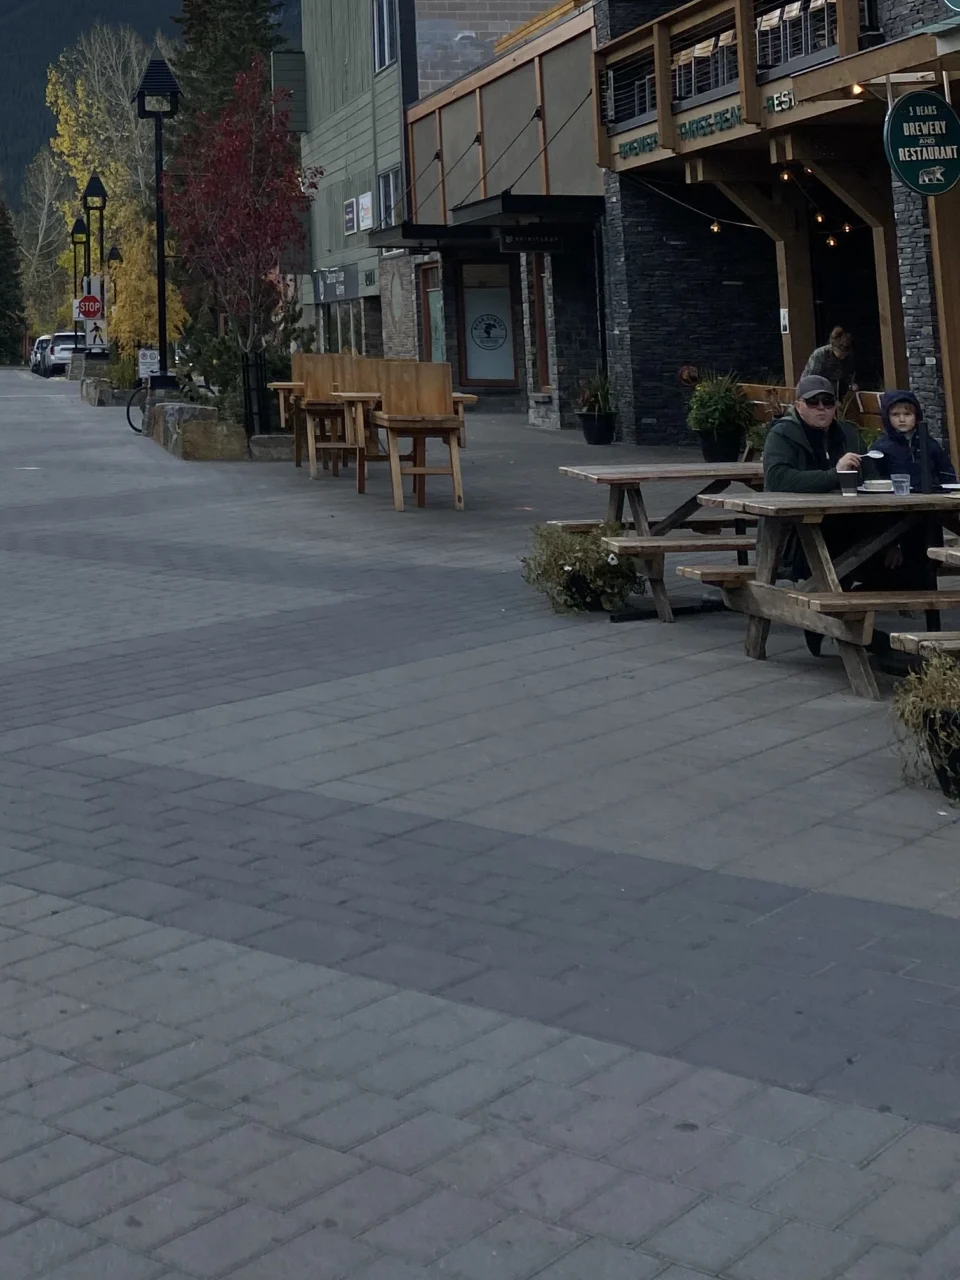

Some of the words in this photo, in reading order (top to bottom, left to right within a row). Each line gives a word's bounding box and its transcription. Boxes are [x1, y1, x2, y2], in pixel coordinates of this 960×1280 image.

[909, 107, 914, 116] 3
[916, 106, 938, 116] BEARS
[677, 114, 714, 141] THREE
[903, 121, 947, 136] BREWERY
[898, 146, 958, 162] RESTAURANT
[80, 302, 100, 312] STOP
